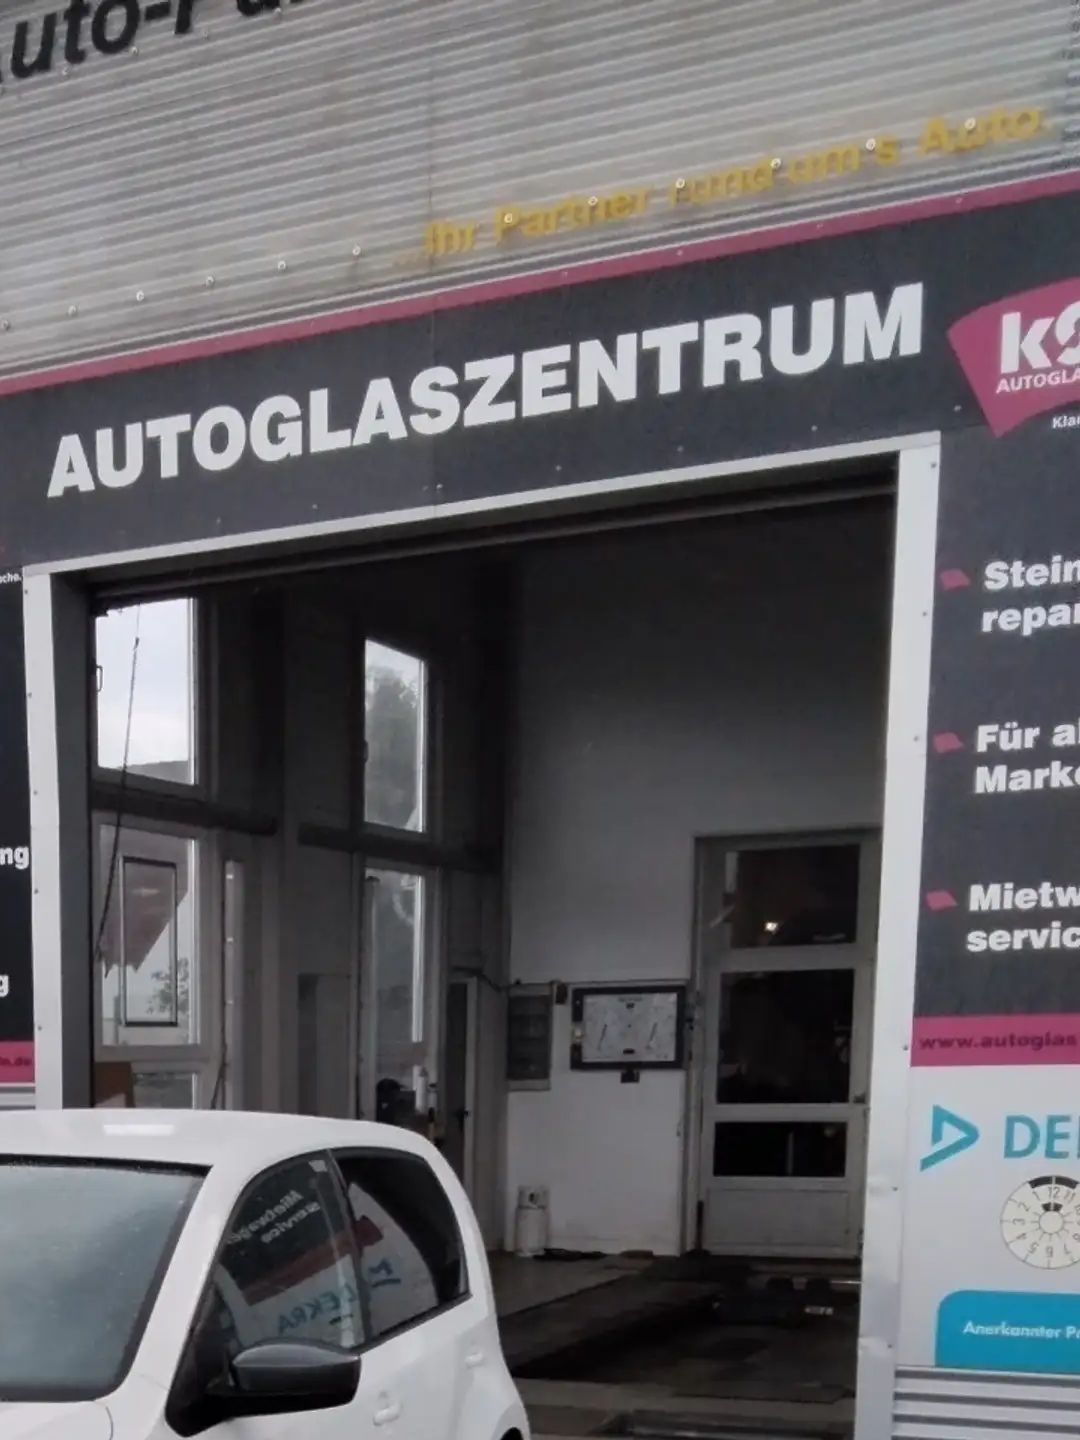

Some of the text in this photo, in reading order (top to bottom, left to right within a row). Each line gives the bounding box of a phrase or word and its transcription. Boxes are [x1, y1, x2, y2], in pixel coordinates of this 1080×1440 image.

[493, 184, 654, 246] Partner
[47, 282, 924, 499] AUTOGLASZENTRUM
[976, 720, 1040, 753] Für
[1003, 1114, 1080, 1159] DE
[963, 1319, 1061, 1339] Anerkannter
